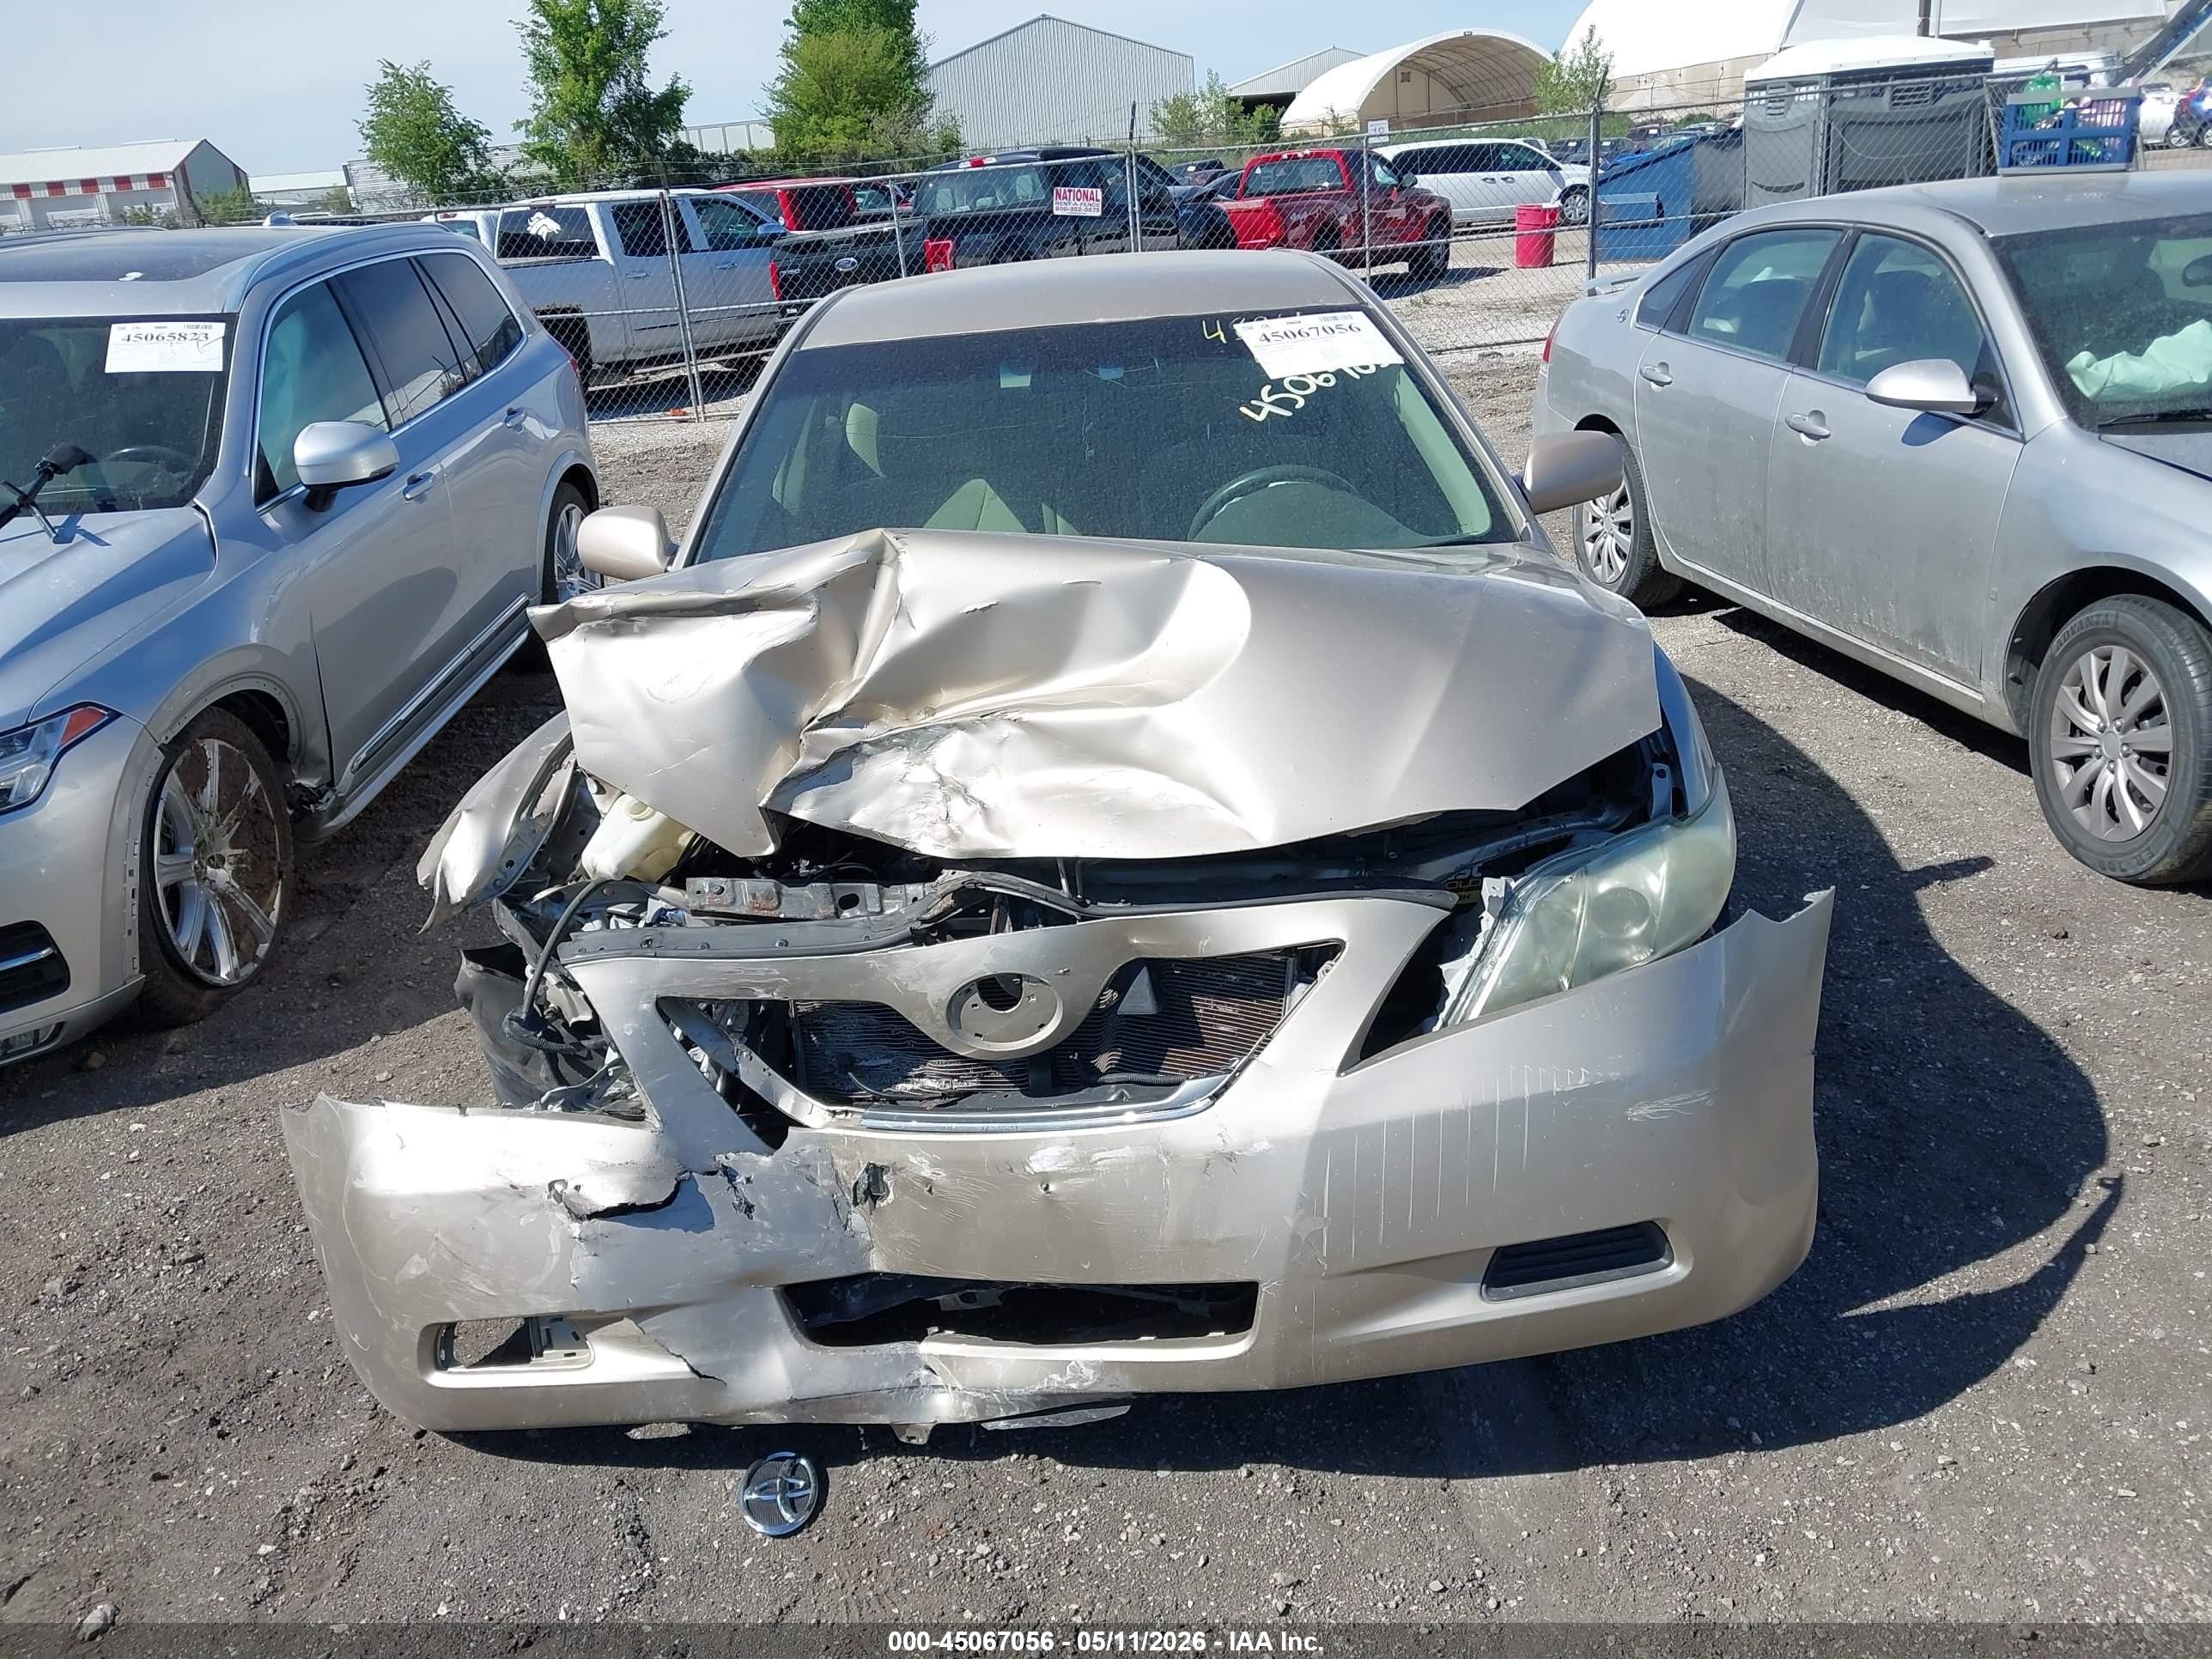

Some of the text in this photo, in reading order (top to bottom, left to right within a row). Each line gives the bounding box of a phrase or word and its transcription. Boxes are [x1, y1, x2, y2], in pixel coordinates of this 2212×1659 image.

[1055, 188, 1100, 202] NATIONAL
[121, 332, 209, 343] 45065823
[1259, 323, 1361, 343] 45067056
